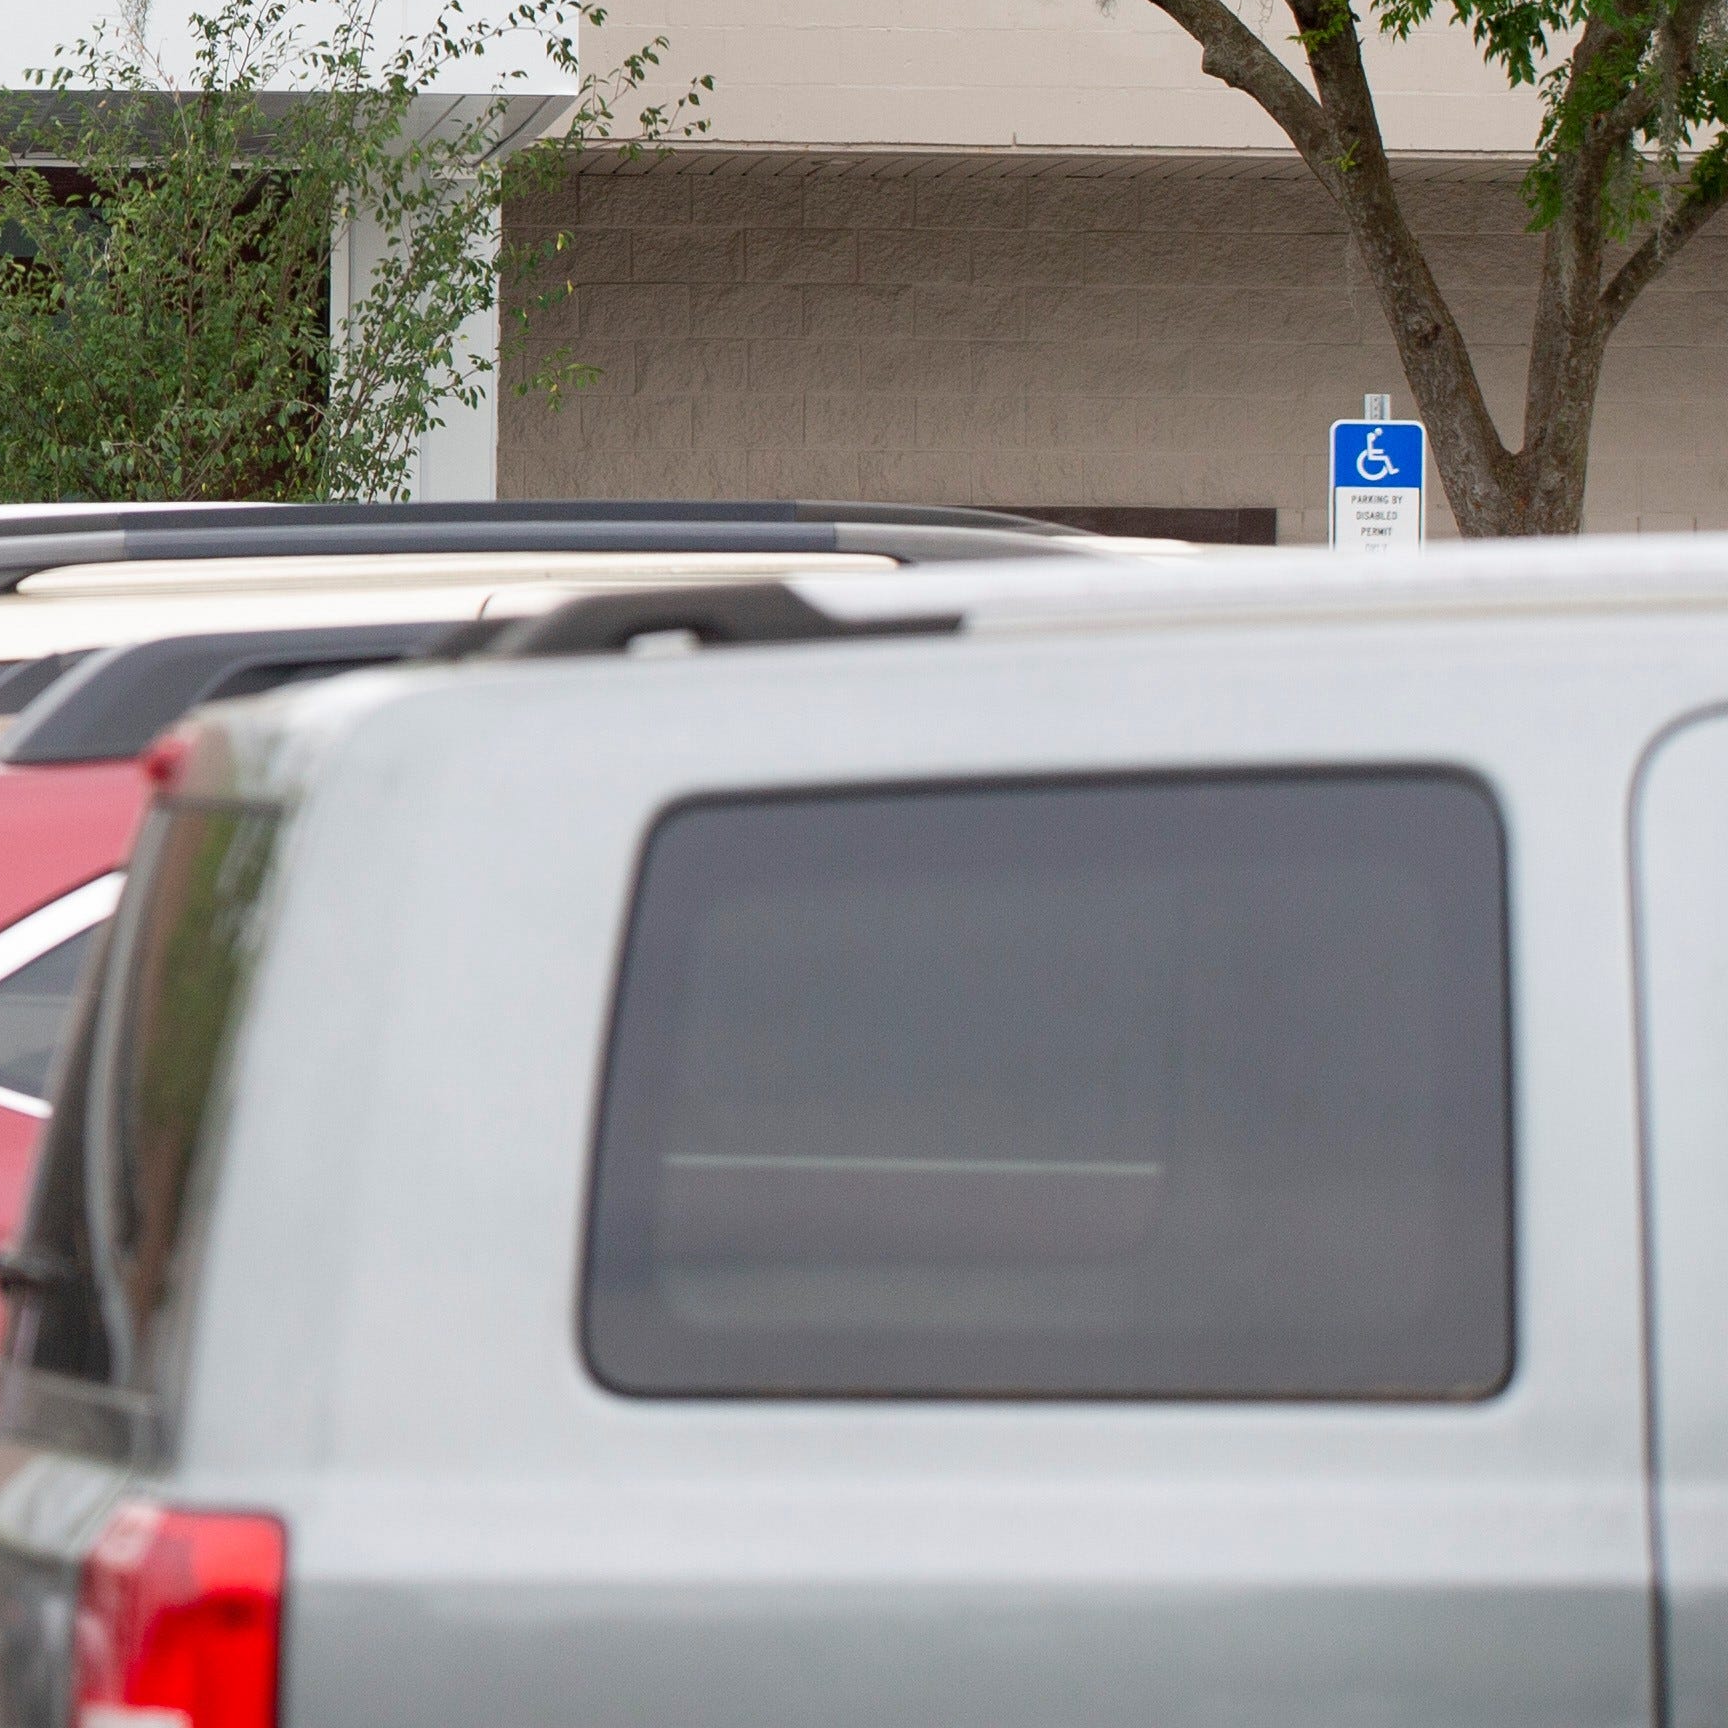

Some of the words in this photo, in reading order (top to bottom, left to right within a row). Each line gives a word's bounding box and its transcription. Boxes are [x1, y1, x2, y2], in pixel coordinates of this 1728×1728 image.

[1350, 495, 1389, 504] PARKING
[1392, 495, 1403, 504] BY
[1356, 511, 1398, 520] DISABLED
[1360, 527, 1392, 536] PERMIT
